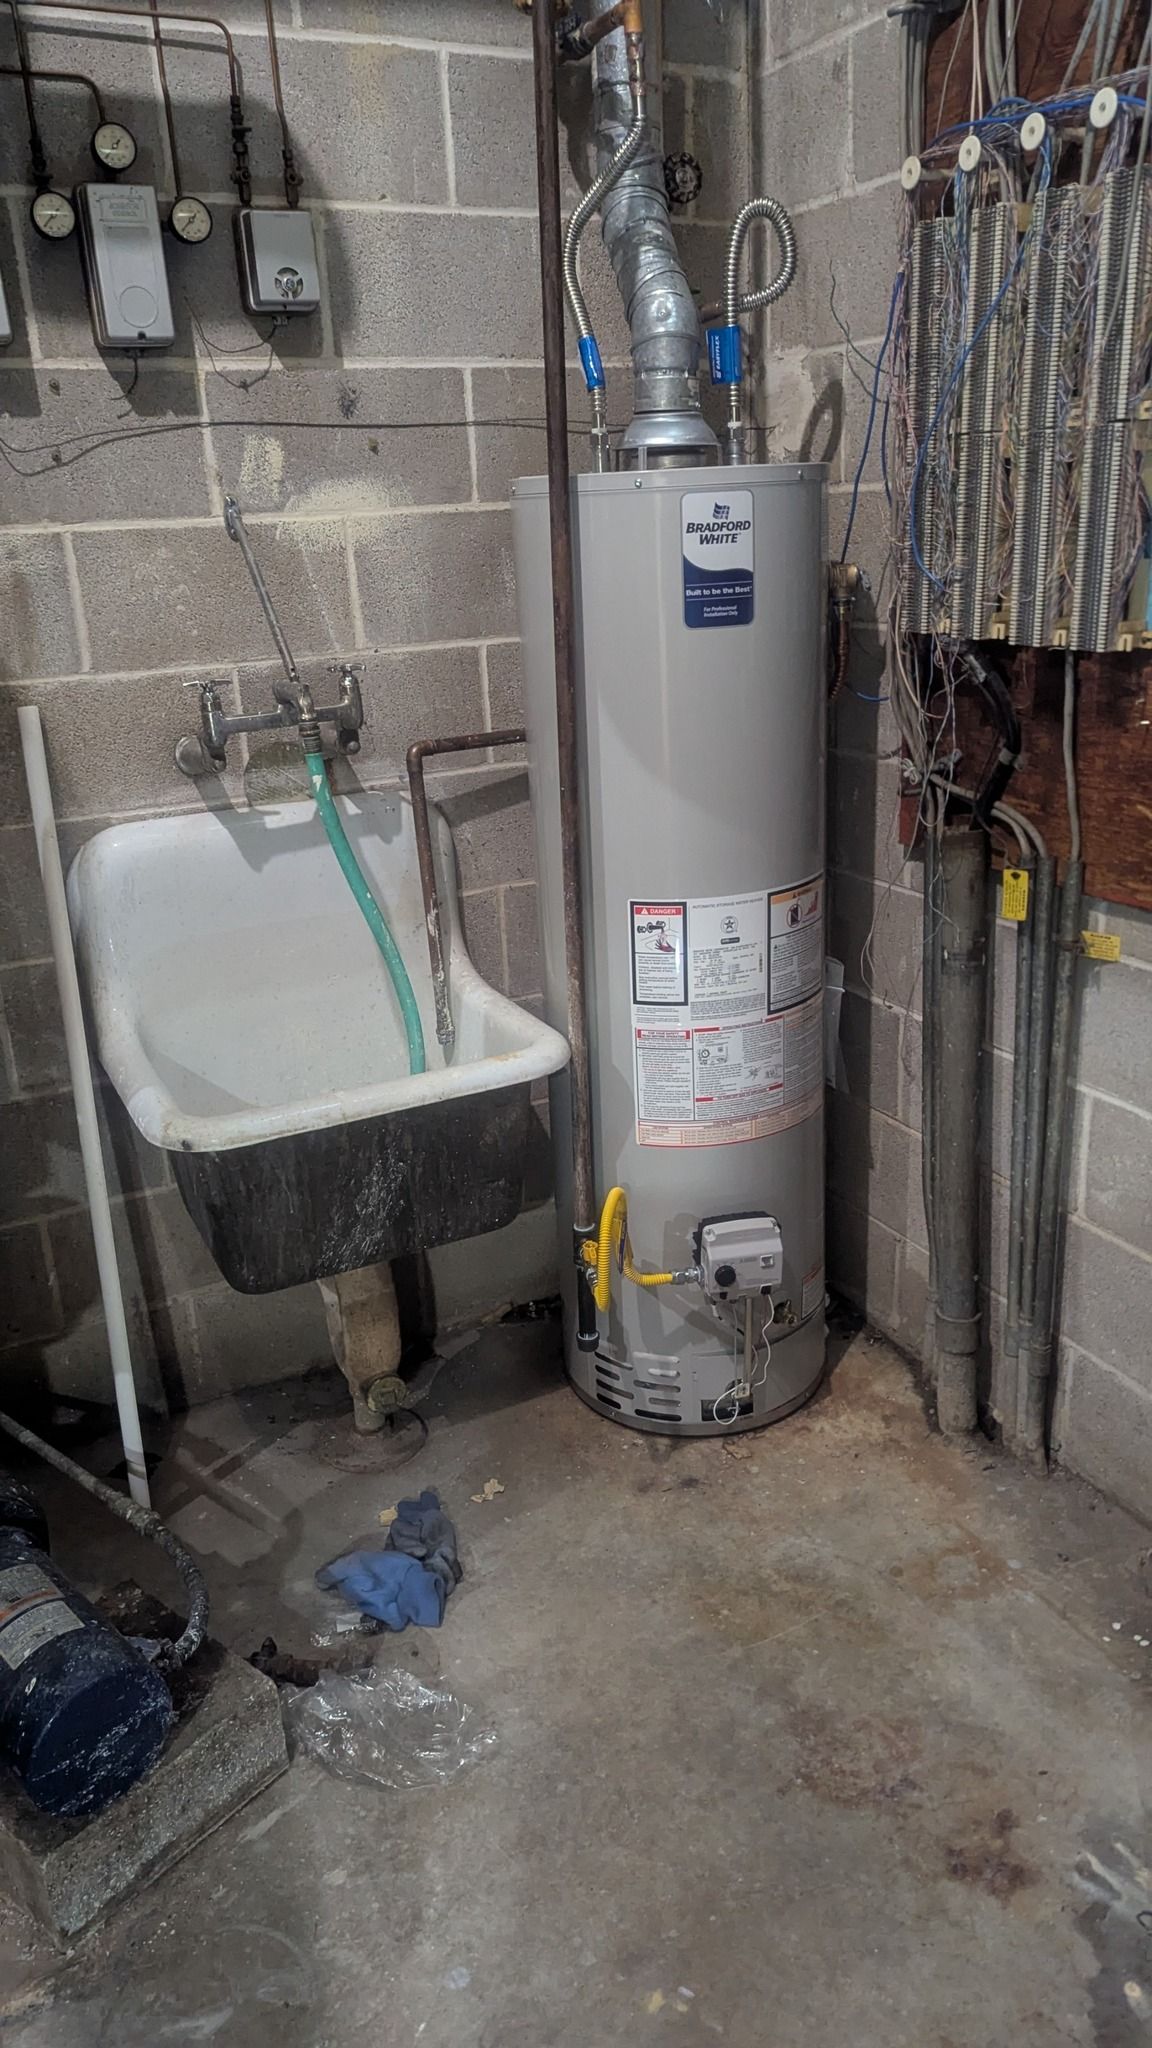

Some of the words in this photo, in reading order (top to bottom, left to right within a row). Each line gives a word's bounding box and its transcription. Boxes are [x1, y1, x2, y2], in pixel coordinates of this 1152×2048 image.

[686, 520, 751, 534] BRADFORD
[699, 533, 738, 545] WHITE
[685, 589, 702, 597] Built
